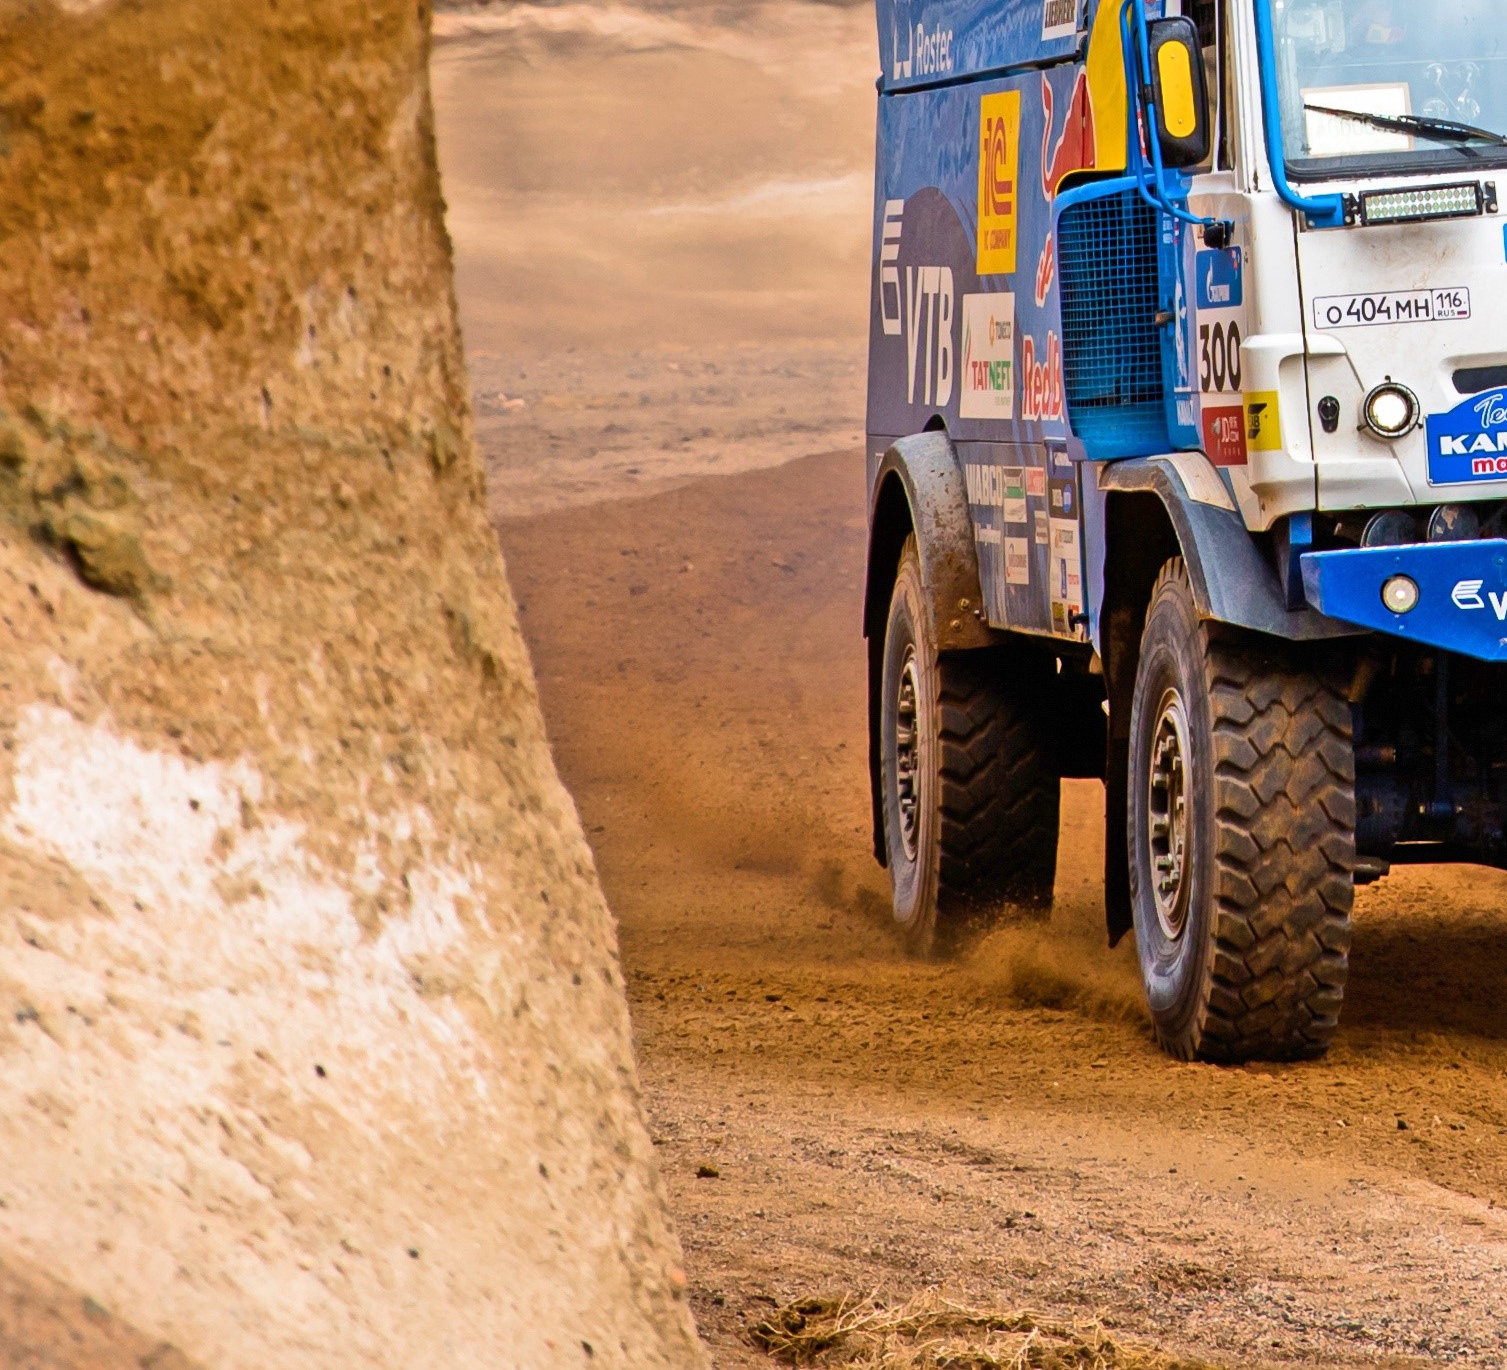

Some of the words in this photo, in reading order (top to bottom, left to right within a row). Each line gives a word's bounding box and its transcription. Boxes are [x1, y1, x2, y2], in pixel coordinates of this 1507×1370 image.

[916, 23, 953, 76] Rostec
[1436, 291, 1462, 309] 116
[906, 265, 954, 407] VTB
[1200, 320, 1242, 393] 300
[971, 361, 1011, 390] TATNEFT
